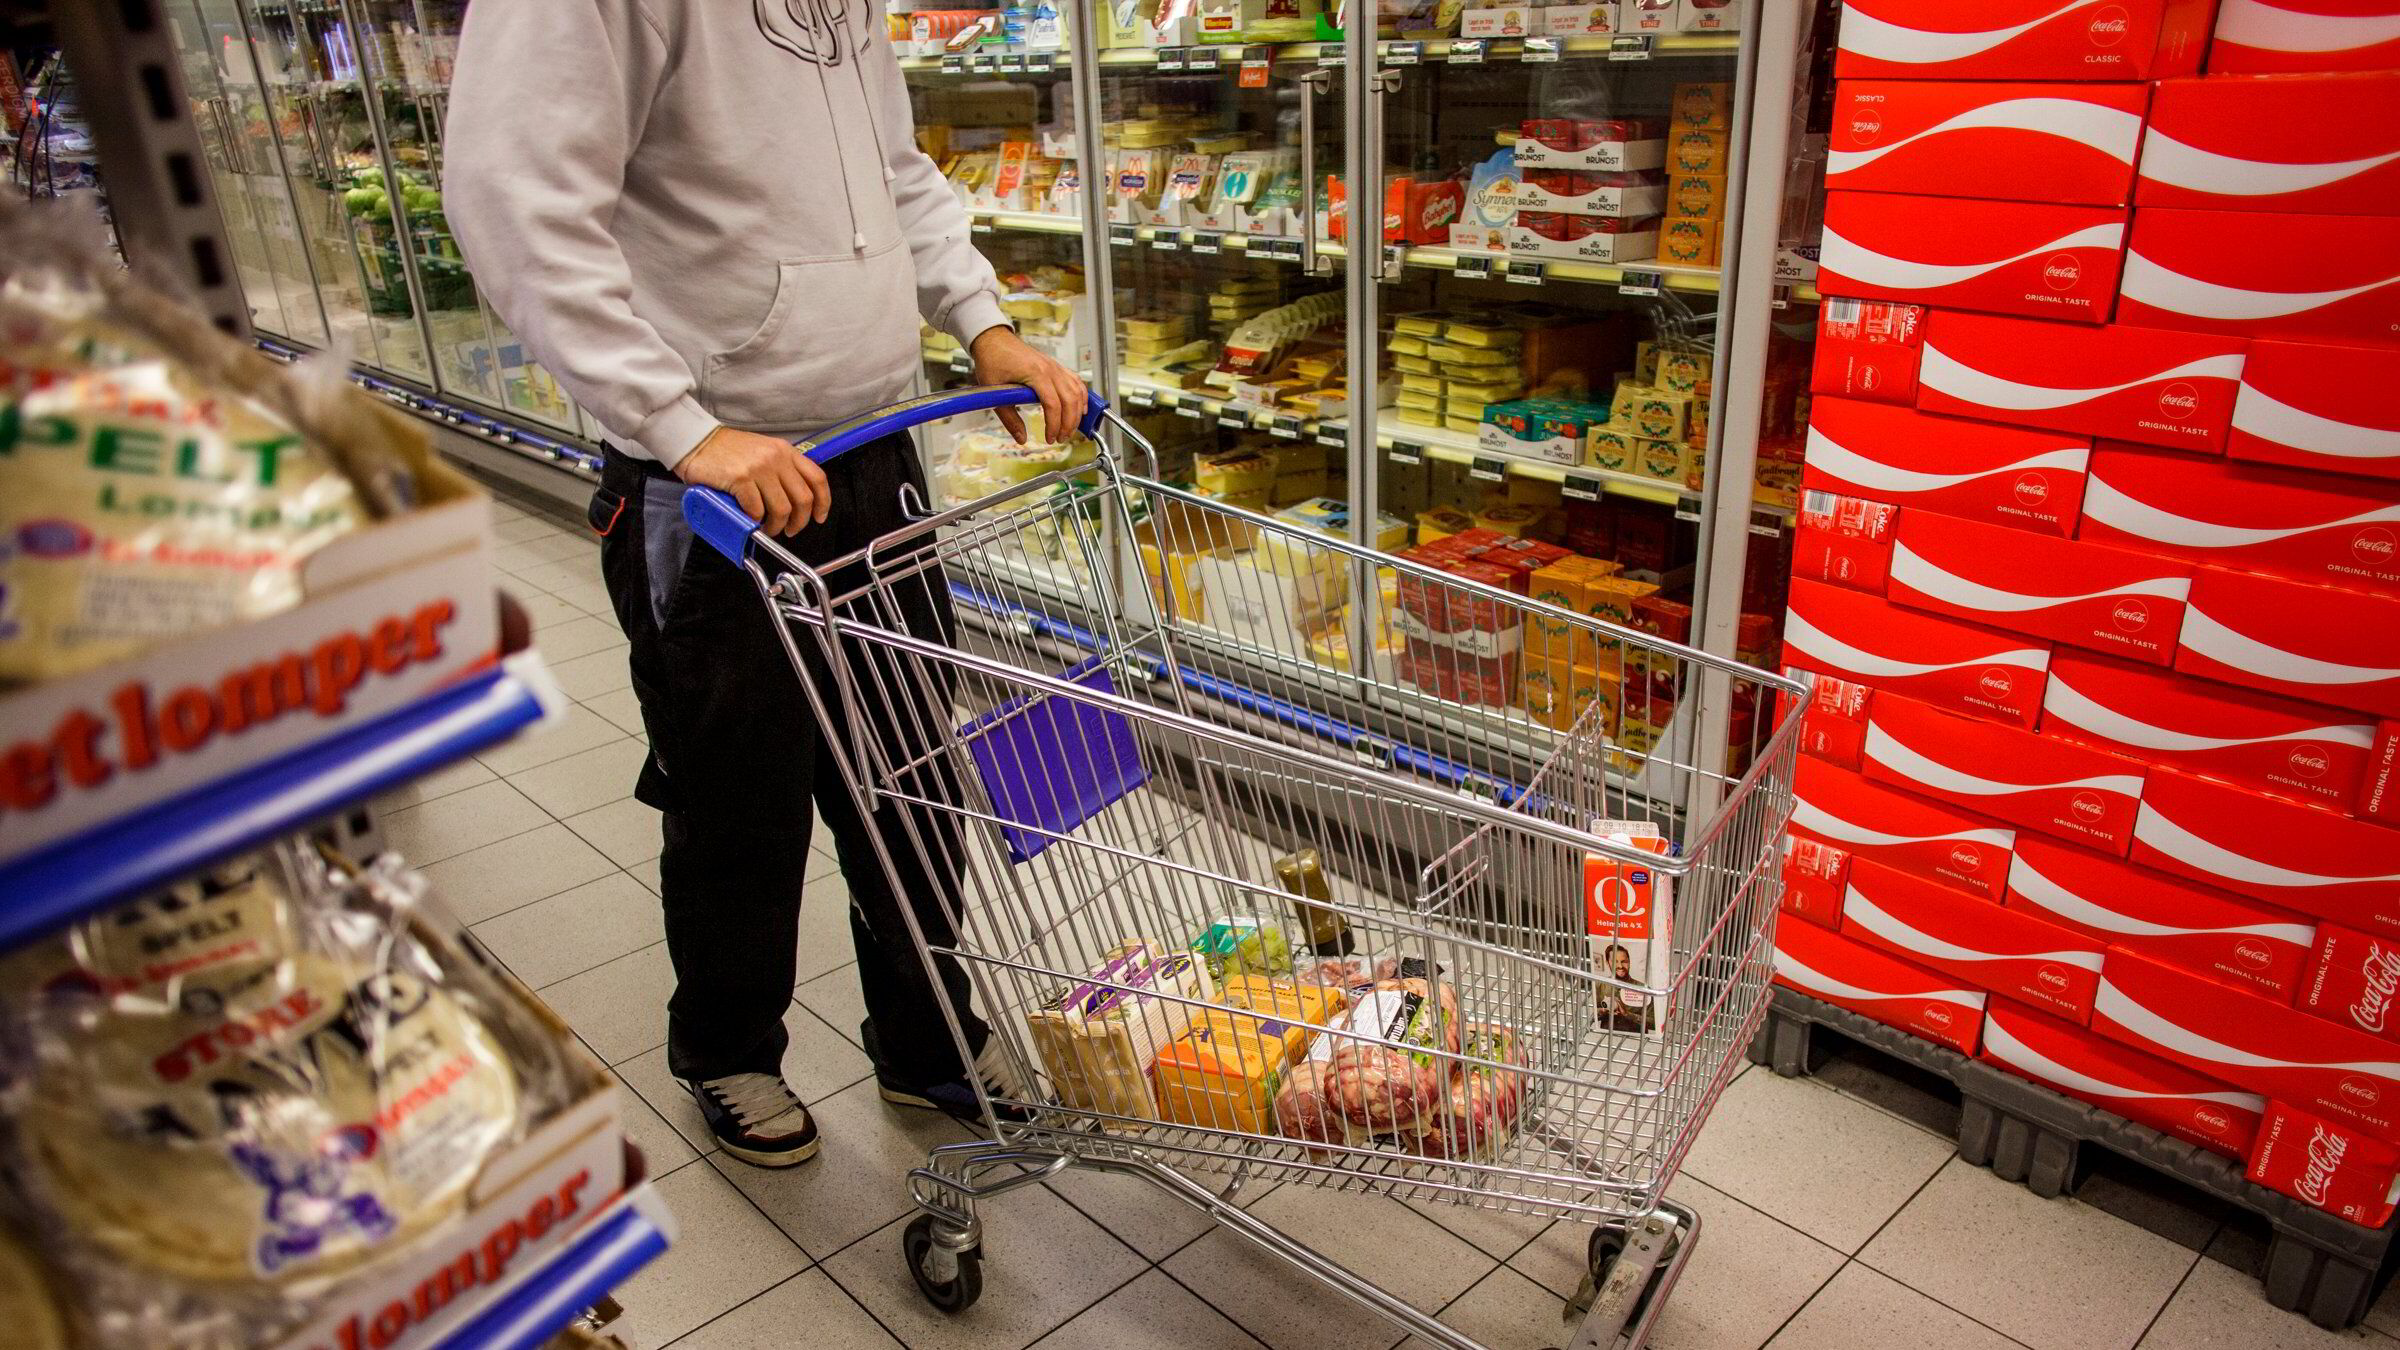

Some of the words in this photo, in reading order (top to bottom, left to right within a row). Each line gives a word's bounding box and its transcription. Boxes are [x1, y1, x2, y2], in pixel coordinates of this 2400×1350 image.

[1701, 20, 1720, 28] TINE
[2085, 55, 2121, 63] CLASSIC
[1515, 153, 1546, 162] BRUNOST
[1585, 156, 1619, 165] BRUNOST
[1518, 198, 1547, 206] BRUNOST
[1587, 203, 1619, 212] BRUNOST
[1511, 242, 1540, 250] BRUNOST
[1579, 247, 1611, 257] BRUNOST
[2025, 293, 2062, 303] ORIGINAL
[2065, 297, 2091, 306] TASTE
[1903, 304, 1919, 334] Coke
[2138, 420, 2178, 432] ORIGINAL
[2181, 426, 2209, 436] TASTE
[1480, 437, 1507, 448] BRUNOST
[1544, 450, 1573, 461] BRUNOST
[1877, 505, 1891, 533] Coke
[1997, 505, 2032, 518] ORIGINAL
[2034, 511, 2058, 523] TASTE
[2327, 564, 2372, 577] ORIGINAL
[2094, 630, 2131, 644] ORIGINAL
[2132, 638, 2158, 650] TASTE
[1853, 685, 1867, 712] Coke
[1963, 695, 1998, 710] ORIGINAL
[1998, 703, 2021, 716] TASTE
[2368, 767, 2391, 813] ORIGINAL
[2382, 735, 2399, 765] TASTE
[2267, 773, 2308, 789] ORIGINAL
[2310, 784, 2339, 797] TASTE
[1603, 821, 1613, 830] 09
[2053, 817, 2088, 833] ORIGINAL
[2089, 828, 2113, 840] TASTE
[1829, 850, 1843, 876] Coke
[1936, 867, 1967, 881] ORIGINAL
[1967, 875, 1989, 889] TASTE
[1594, 876, 1646, 916] Q
[2214, 962, 2254, 981] ORIGINAL
[2255, 976, 2281, 990] TASTE
[2309, 962, 2331, 1006] ORIGINAL
[2322, 936, 2337, 965] TASTE
[2021, 985, 2055, 1003] ORIGINAL
[2056, 996, 2078, 1011] TASTE
[152, 985, 322, 1085] STORE
[1910, 1022, 1938, 1036] ORIGINAL
[1938, 1032, 1961, 1046] TASTE
[2316, 1098, 2358, 1118] ORIGINAL
[2360, 1113, 2391, 1128] TASTE
[2175, 1124, 2211, 1142] ORIGINAL
[2212, 1138, 2239, 1152] TASTE
[2256, 1140, 2274, 1178] ORIGINAL
[2269, 1115, 2285, 1141] TASTE
[2343, 1205, 2355, 1216] 10
